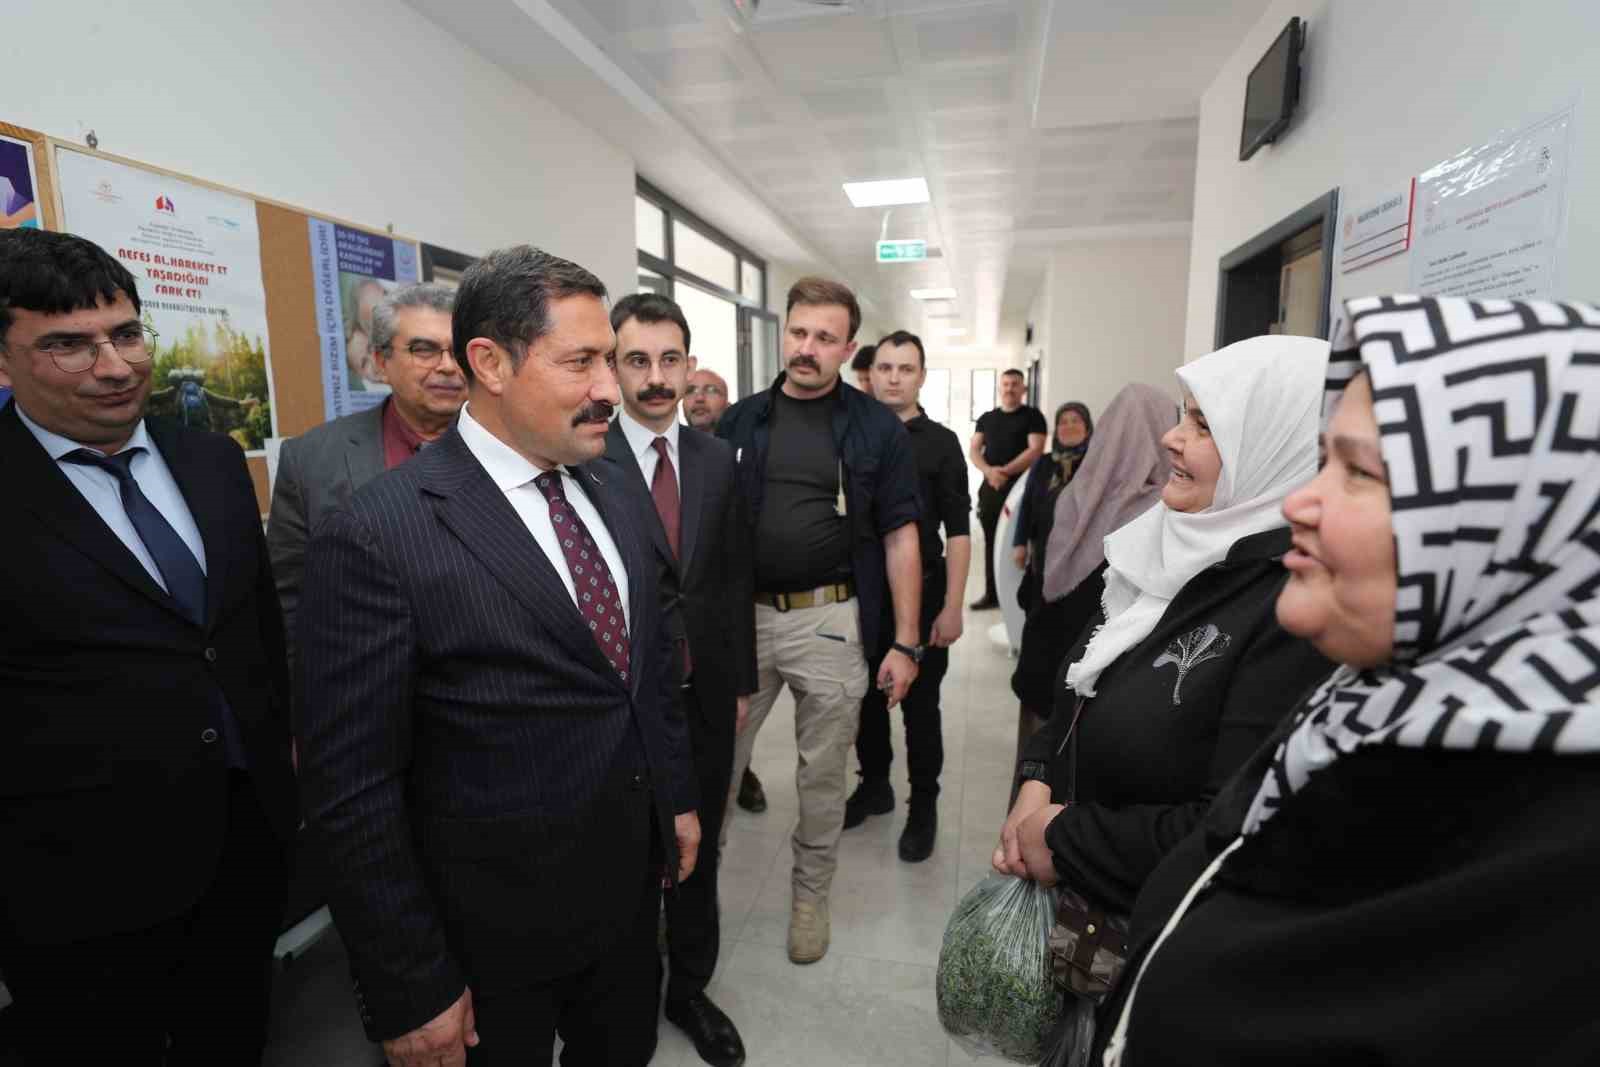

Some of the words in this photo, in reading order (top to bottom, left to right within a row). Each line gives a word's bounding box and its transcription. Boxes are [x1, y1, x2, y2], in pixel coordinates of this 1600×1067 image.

[118, 248, 151, 263] NEFES
[217, 265, 228, 275] ET
[146, 267, 209, 286] YAŞADIĞINI
[155, 284, 183, 297] FARK
[186, 288, 201, 299] ET!
